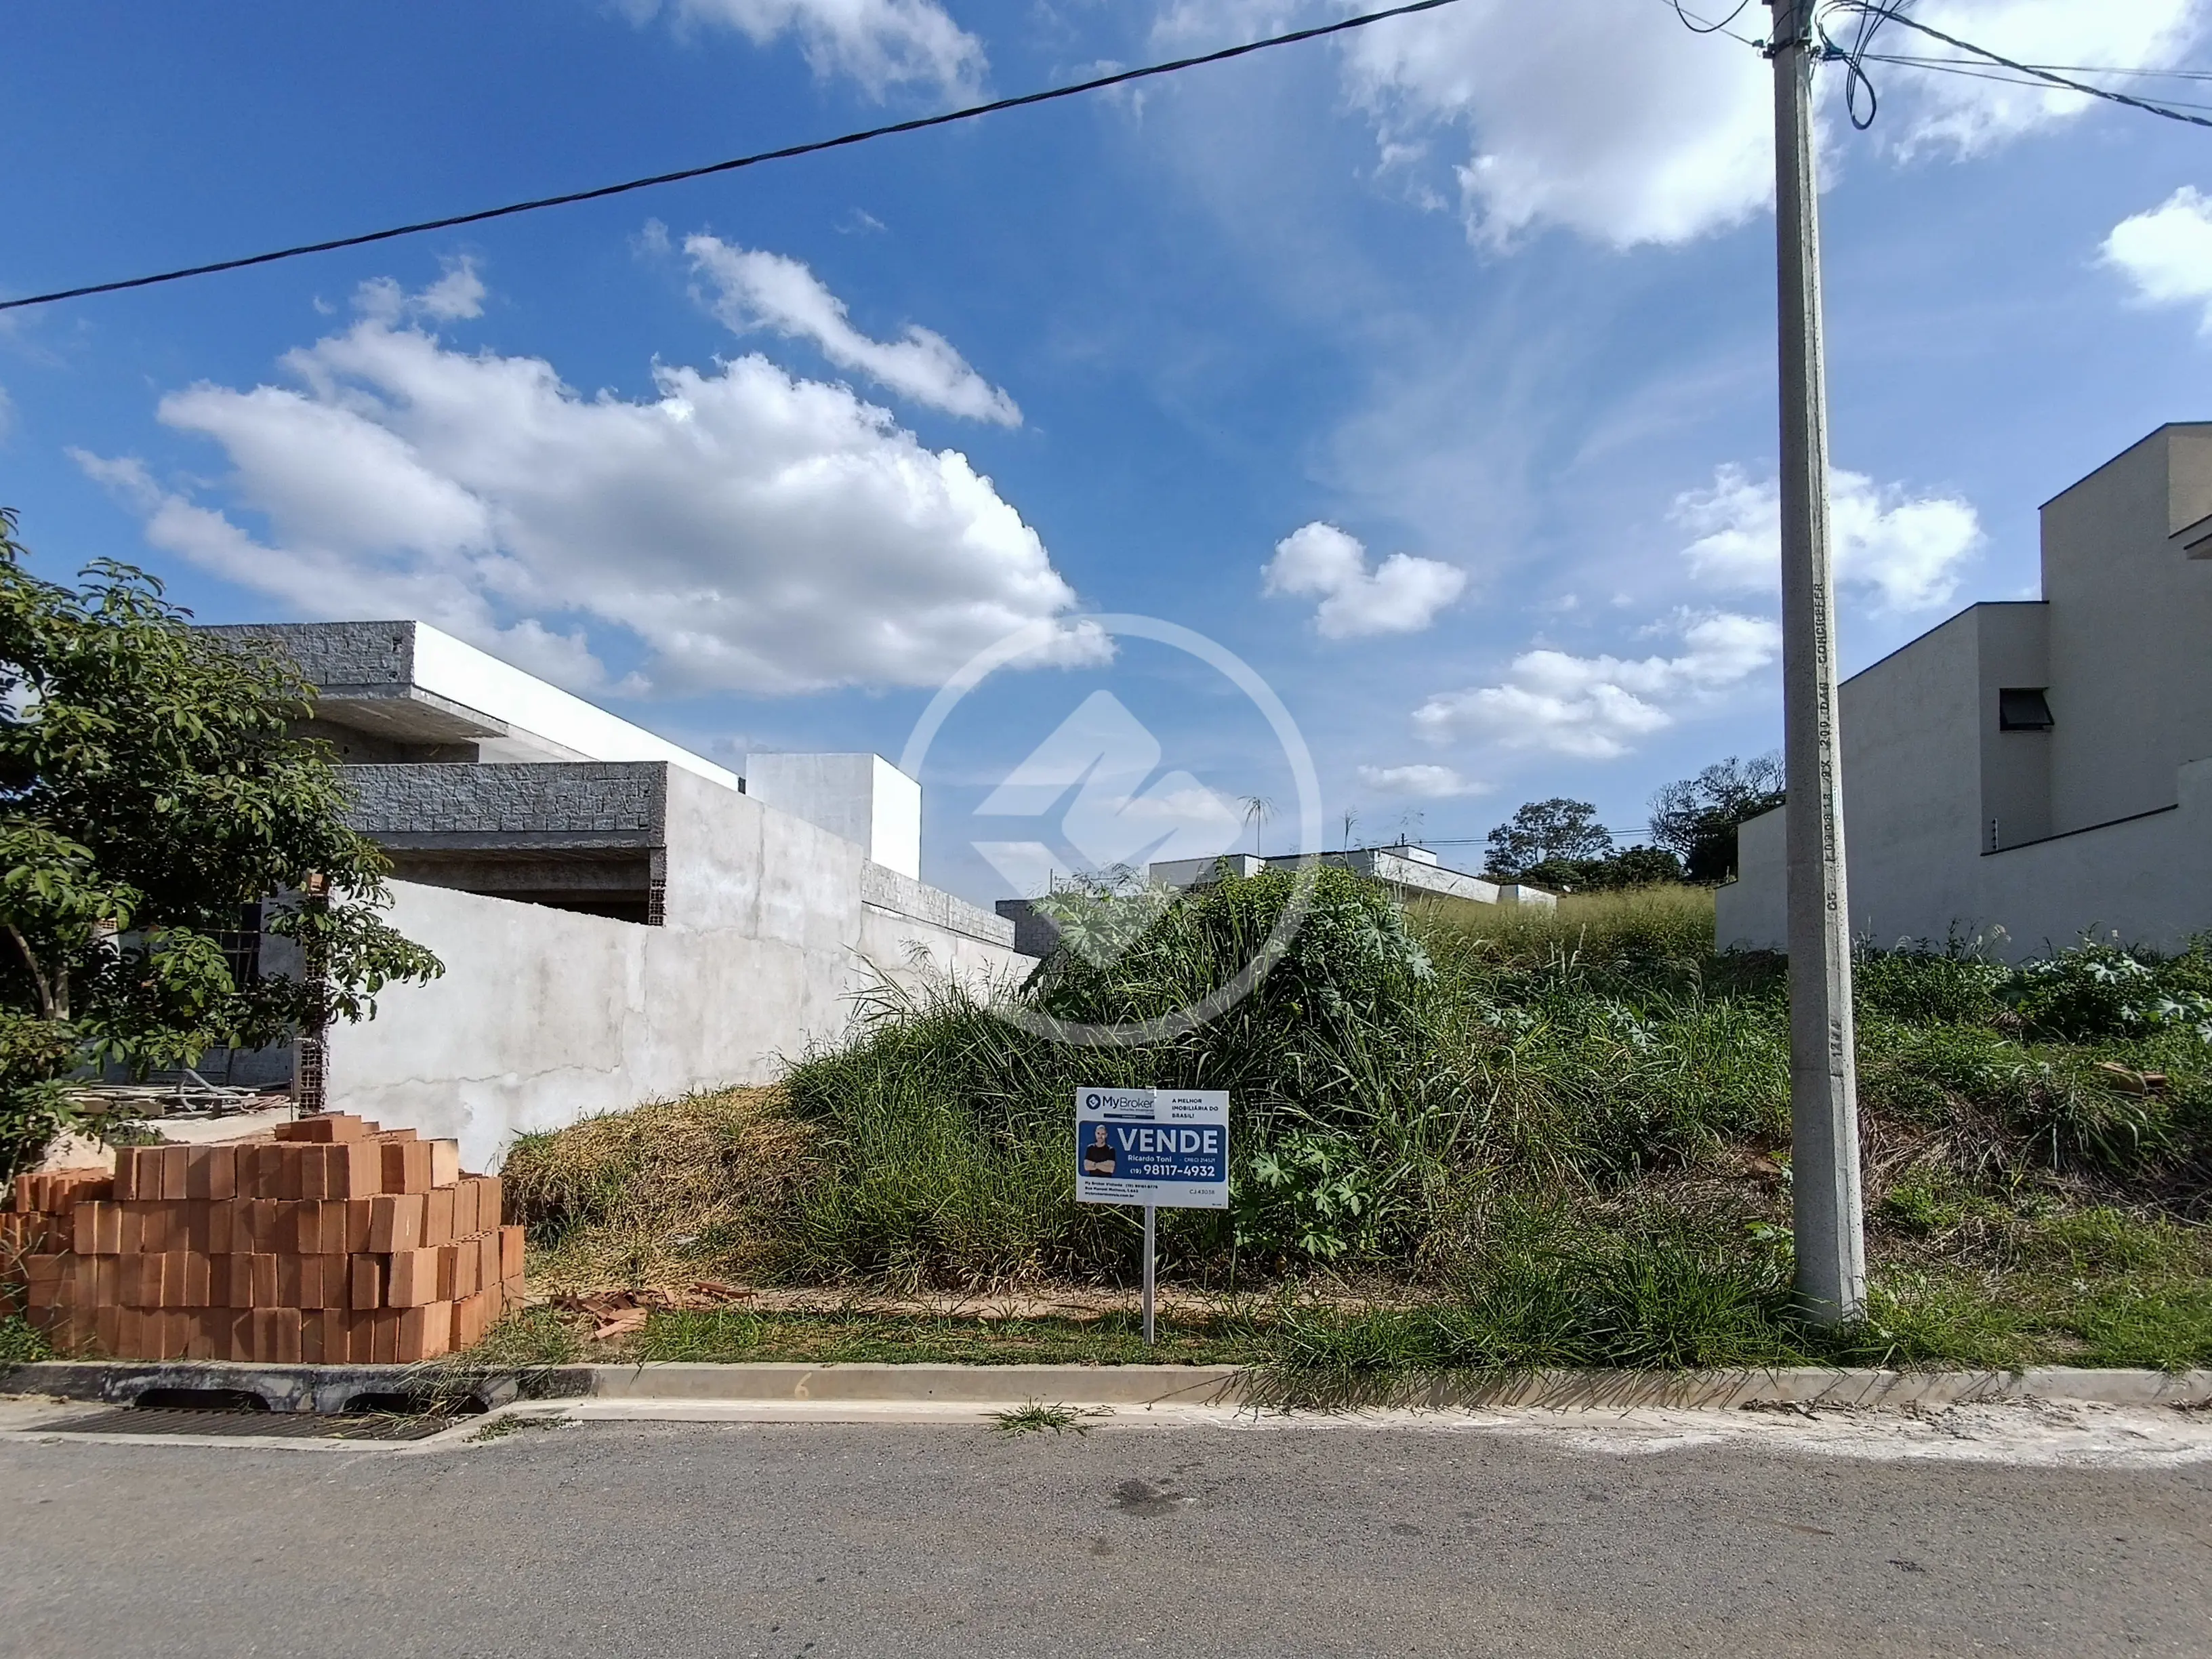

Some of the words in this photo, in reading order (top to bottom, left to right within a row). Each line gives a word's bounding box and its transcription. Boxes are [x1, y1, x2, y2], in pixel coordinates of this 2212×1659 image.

[1103, 1096, 1154, 1109] MyBroker
[1117, 1127, 1218, 1153] VENDE
[1143, 1164, 1215, 1177] 98117-4932
[794, 1372, 812, 1400] 6
